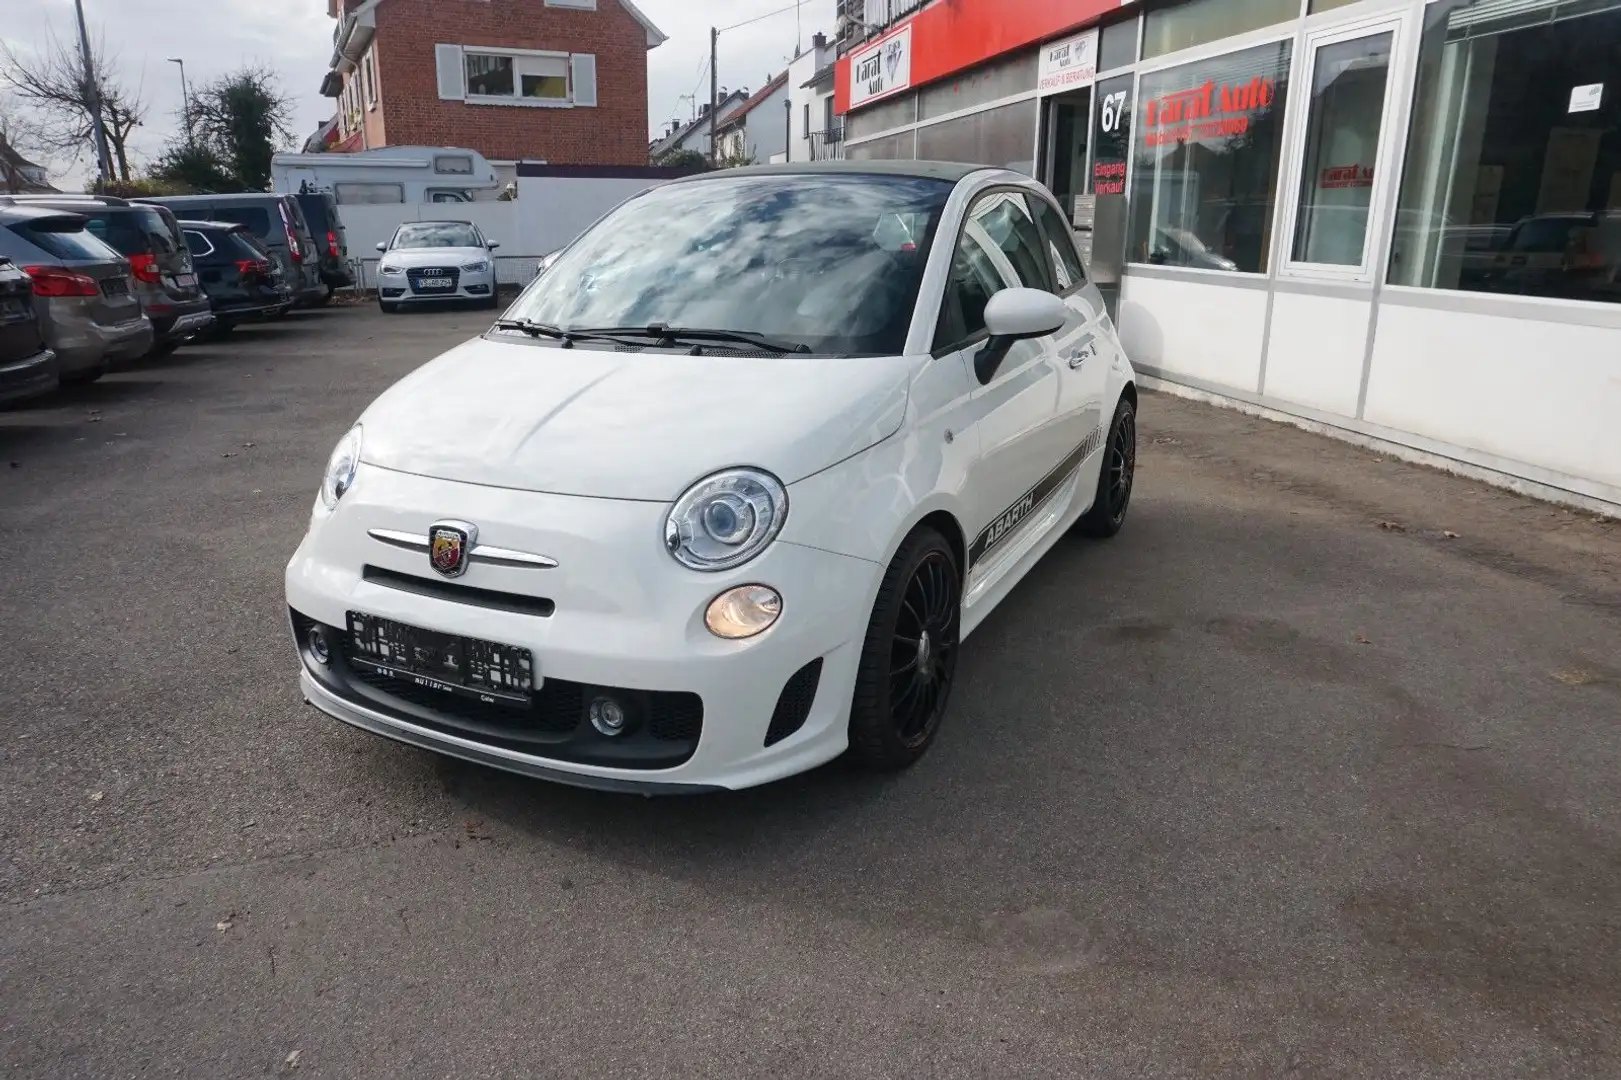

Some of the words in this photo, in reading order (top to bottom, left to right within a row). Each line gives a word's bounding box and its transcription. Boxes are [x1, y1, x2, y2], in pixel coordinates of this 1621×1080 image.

[1102, 90, 1127, 132] 67
[1095, 162, 1126, 176] Eingang
[985, 492, 1034, 549] ABARTH
